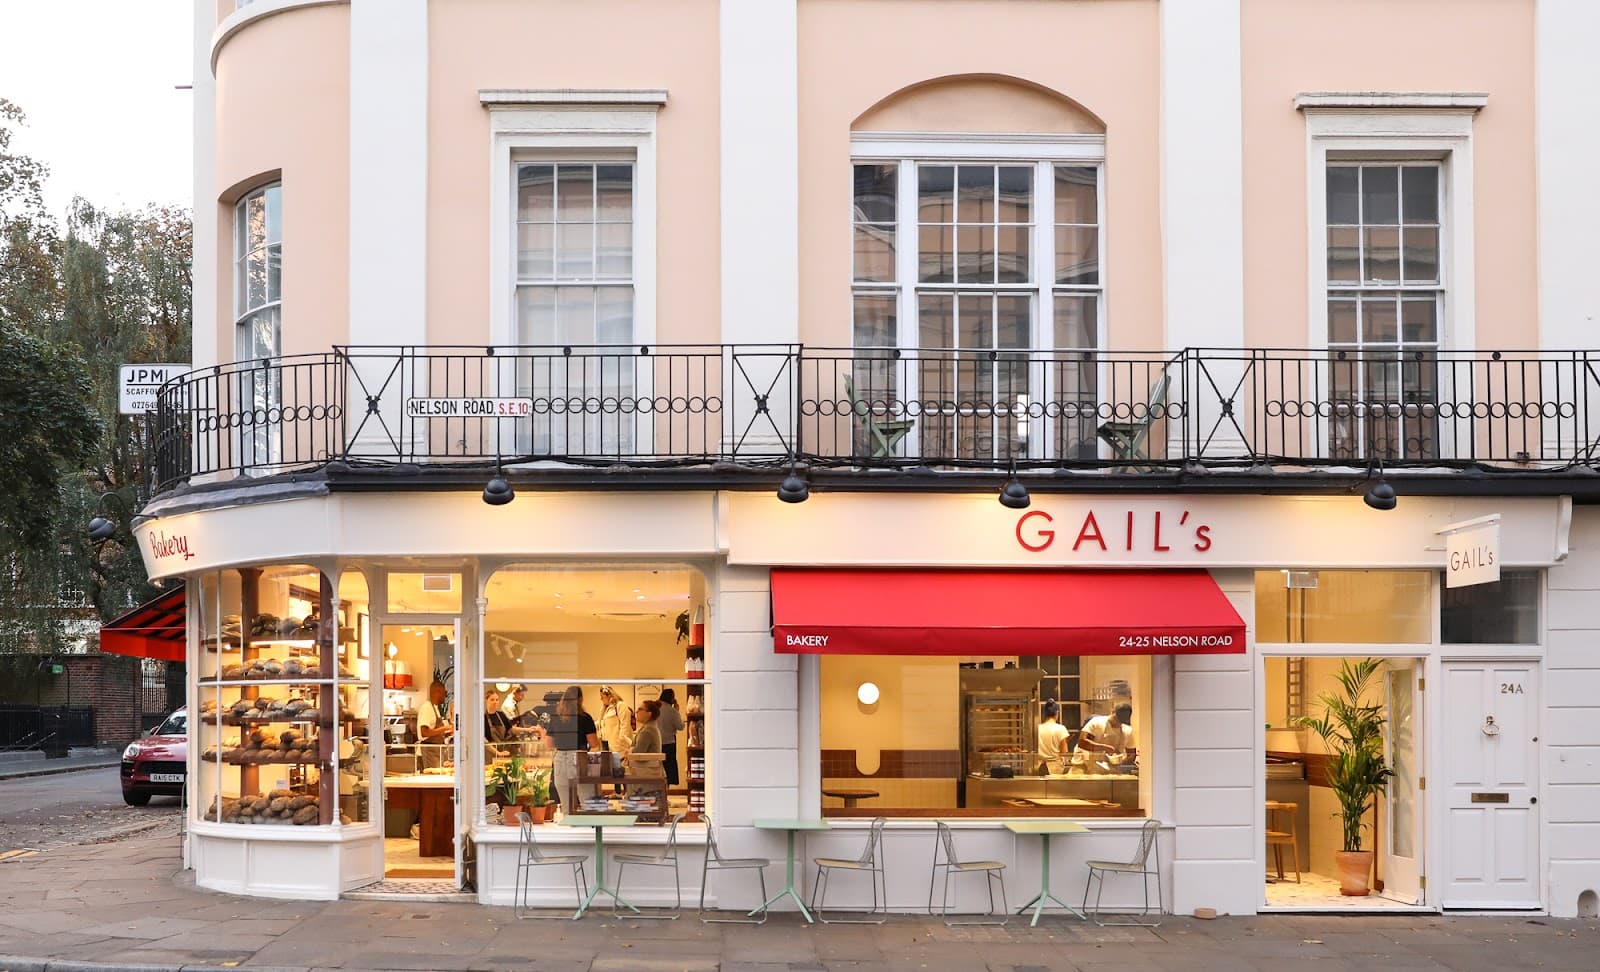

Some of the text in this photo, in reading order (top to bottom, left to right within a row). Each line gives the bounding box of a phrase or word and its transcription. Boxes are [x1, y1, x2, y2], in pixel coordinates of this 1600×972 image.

[411, 400, 457, 415] NELSON
[149, 530, 195, 560] Bakery
[786, 634, 829, 646] BAKERY
[1119, 635, 1233, 647] 24-25 NELSON ROAD
[1500, 682, 1524, 694] 24A
